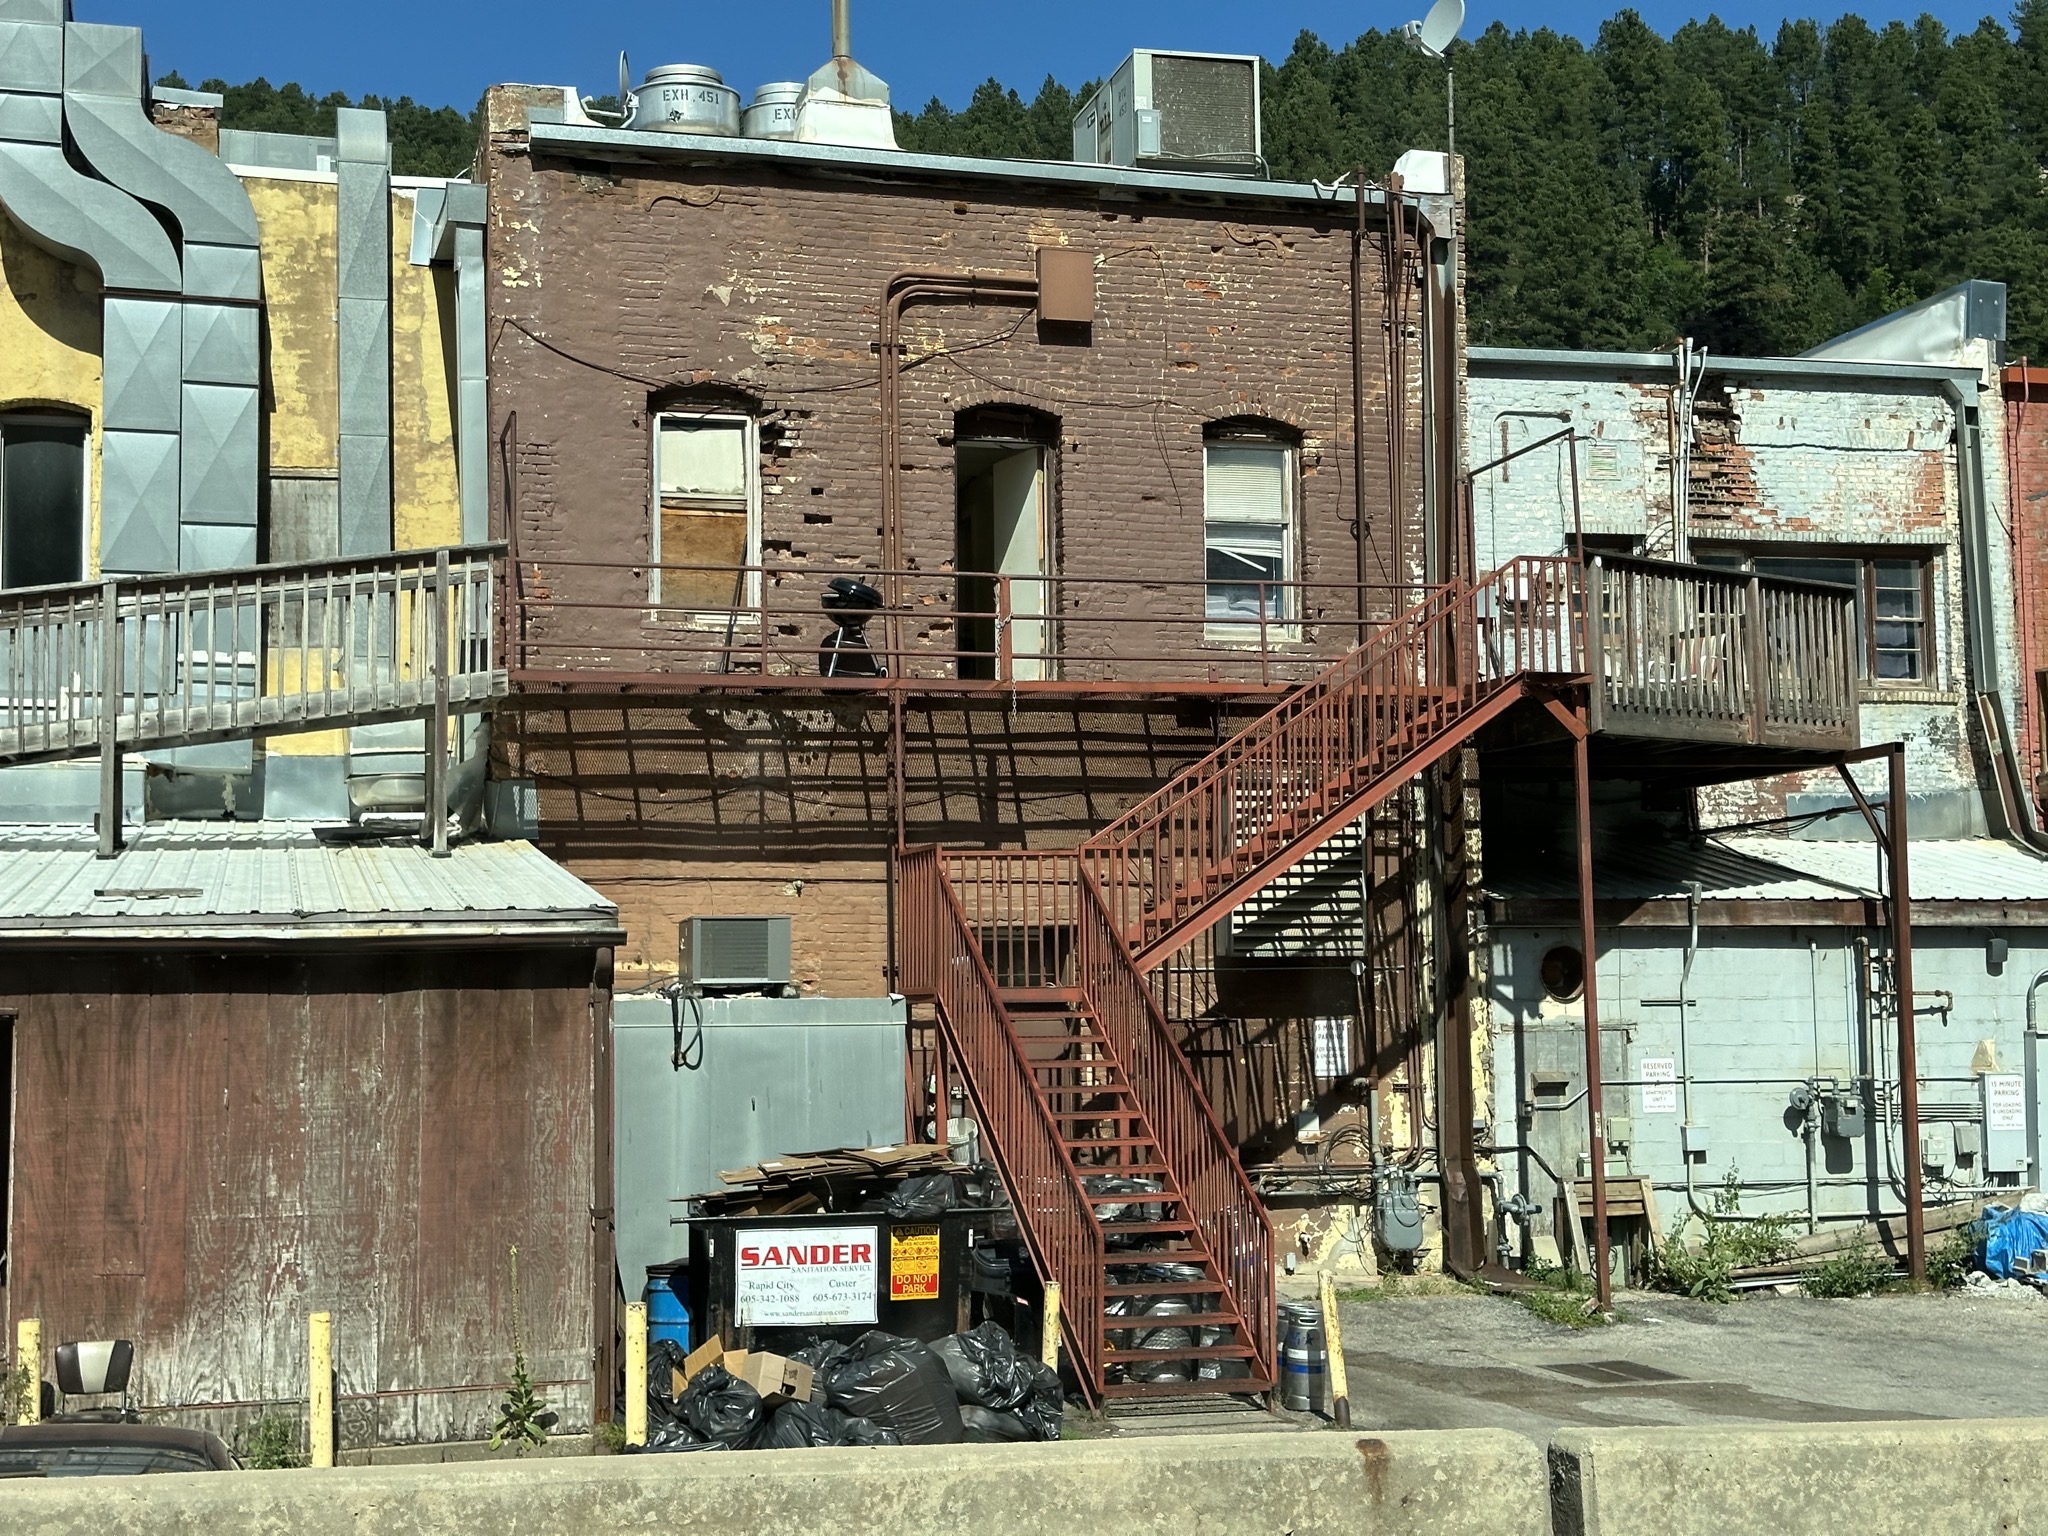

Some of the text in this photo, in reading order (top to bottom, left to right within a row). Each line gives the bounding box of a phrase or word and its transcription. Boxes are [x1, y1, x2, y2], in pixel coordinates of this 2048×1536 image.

[662, 89, 719, 104] EXH 451
[904, 1226, 937, 1235] CAUTION
[741, 1243, 872, 1266] SANDER
[791, 1264, 873, 1274] SANITATION SERVICE
[828, 1278, 858, 1288] Custer
[896, 1274, 934, 1285] DO NOT
[748, 1280, 795, 1291] Rapid City
[903, 1284, 927, 1294] PARK
[740, 1294, 801, 1304] 605-342-1088
[812, 1292, 872, 1302] 605-673-3174
